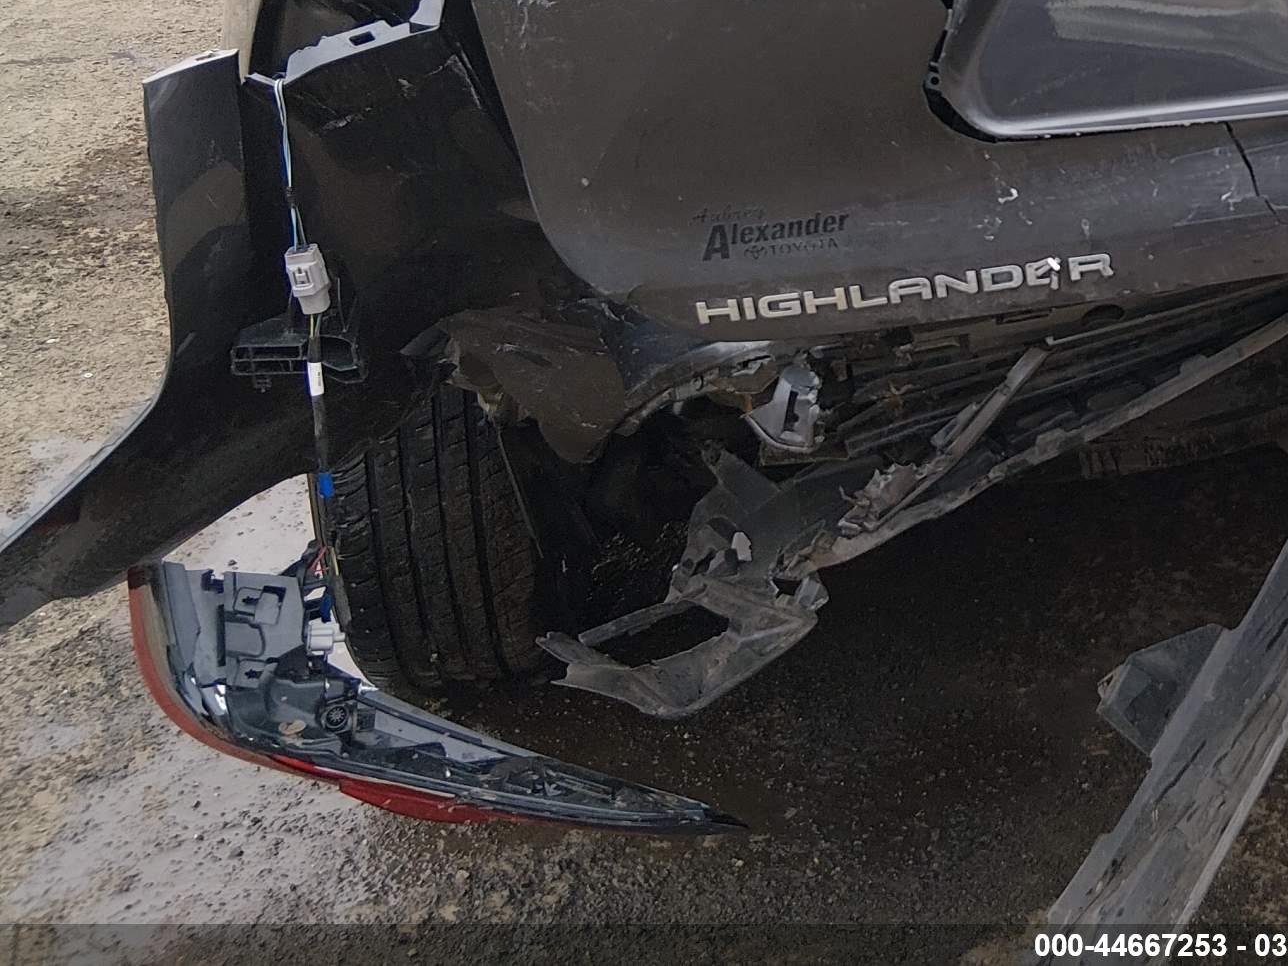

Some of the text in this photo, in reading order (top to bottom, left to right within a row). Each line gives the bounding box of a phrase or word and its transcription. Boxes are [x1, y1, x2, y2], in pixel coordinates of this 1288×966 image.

[702, 212, 849, 262] Alexander
[770, 237, 839, 257] TOYOTA
[696, 252, 1114, 325] HIGHLANDER
